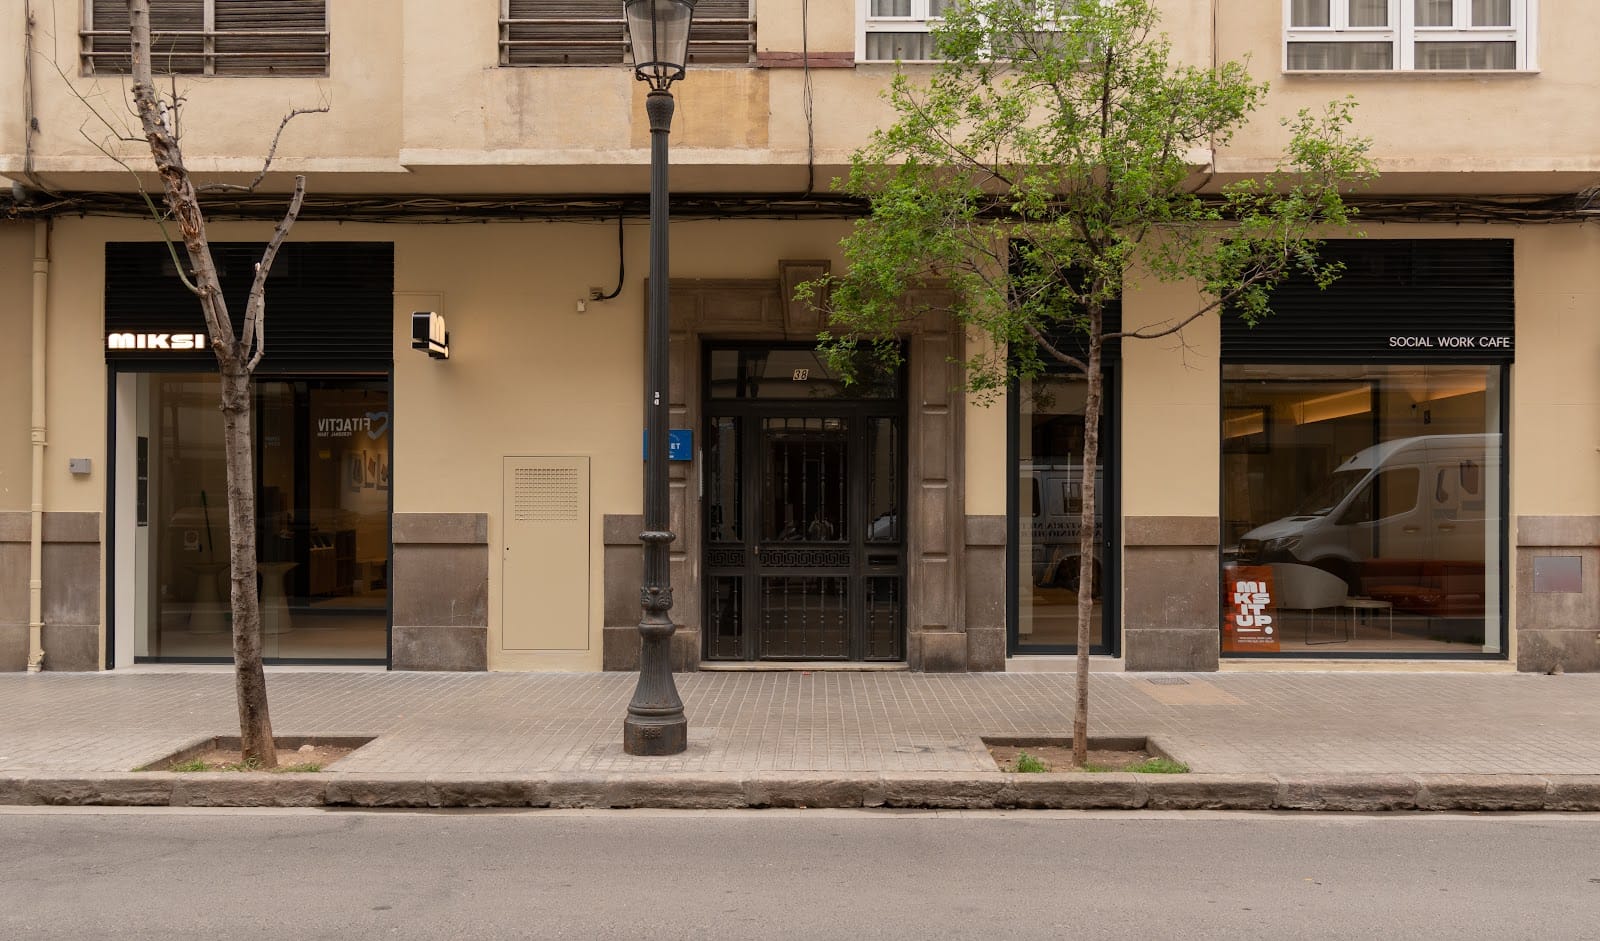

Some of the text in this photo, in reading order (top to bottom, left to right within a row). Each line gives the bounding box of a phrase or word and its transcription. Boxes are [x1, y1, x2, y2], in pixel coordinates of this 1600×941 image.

[108, 333, 205, 349] MIKSI
[1389, 336, 1510, 347] SOCIAL WORK CAFE
[794, 370, 807, 379] 38
[1234, 593, 1270, 604] KS
[1241, 604, 1265, 615] IT
